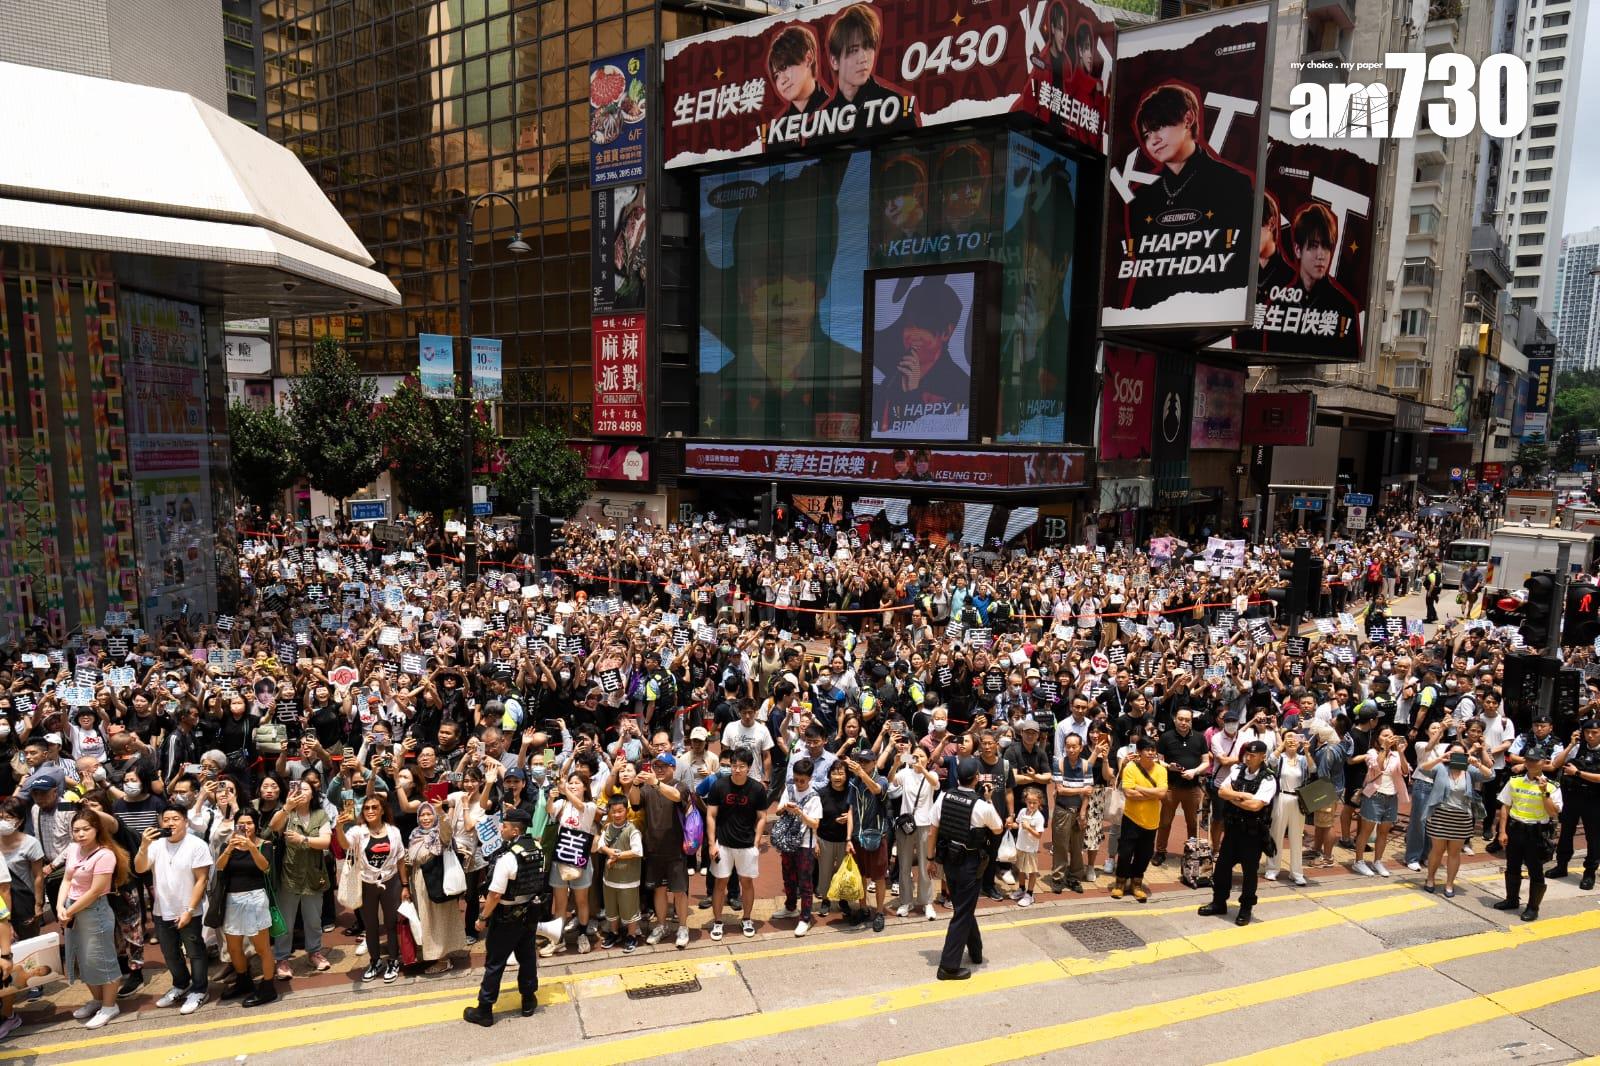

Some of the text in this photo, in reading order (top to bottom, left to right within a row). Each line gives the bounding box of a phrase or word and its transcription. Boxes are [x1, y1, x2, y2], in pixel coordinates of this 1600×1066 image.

[901, 24, 1008, 81] 0430
[672, 77, 766, 127] 生日快樂
[1038, 79, 1101, 135] 姜濤生日快樂
[628, 128, 643, 141] 6/F
[1203, 92, 1259, 154] T
[1110, 147, 1161, 204] K
[1310, 176, 1370, 278] T
[1138, 228, 1219, 254] HAPPY
[1118, 252, 1236, 279] BIRTHDAY
[593, 286, 603, 296] 3F
[1270, 286, 1303, 303] 0430
[622, 317, 636, 328] 4/F
[602, 333, 638, 361] 麻辣
[602, 364, 638, 391] 派對
[1536, 364, 1550, 407] IKEA
[904, 402, 952, 416] HAPPY
[1118, 406, 1134, 426] 莎莎
[598, 421, 642, 431] 2178 4898
[775, 453, 865, 474] 姜濤生日快樂
[556, 830, 587, 865] 姜
